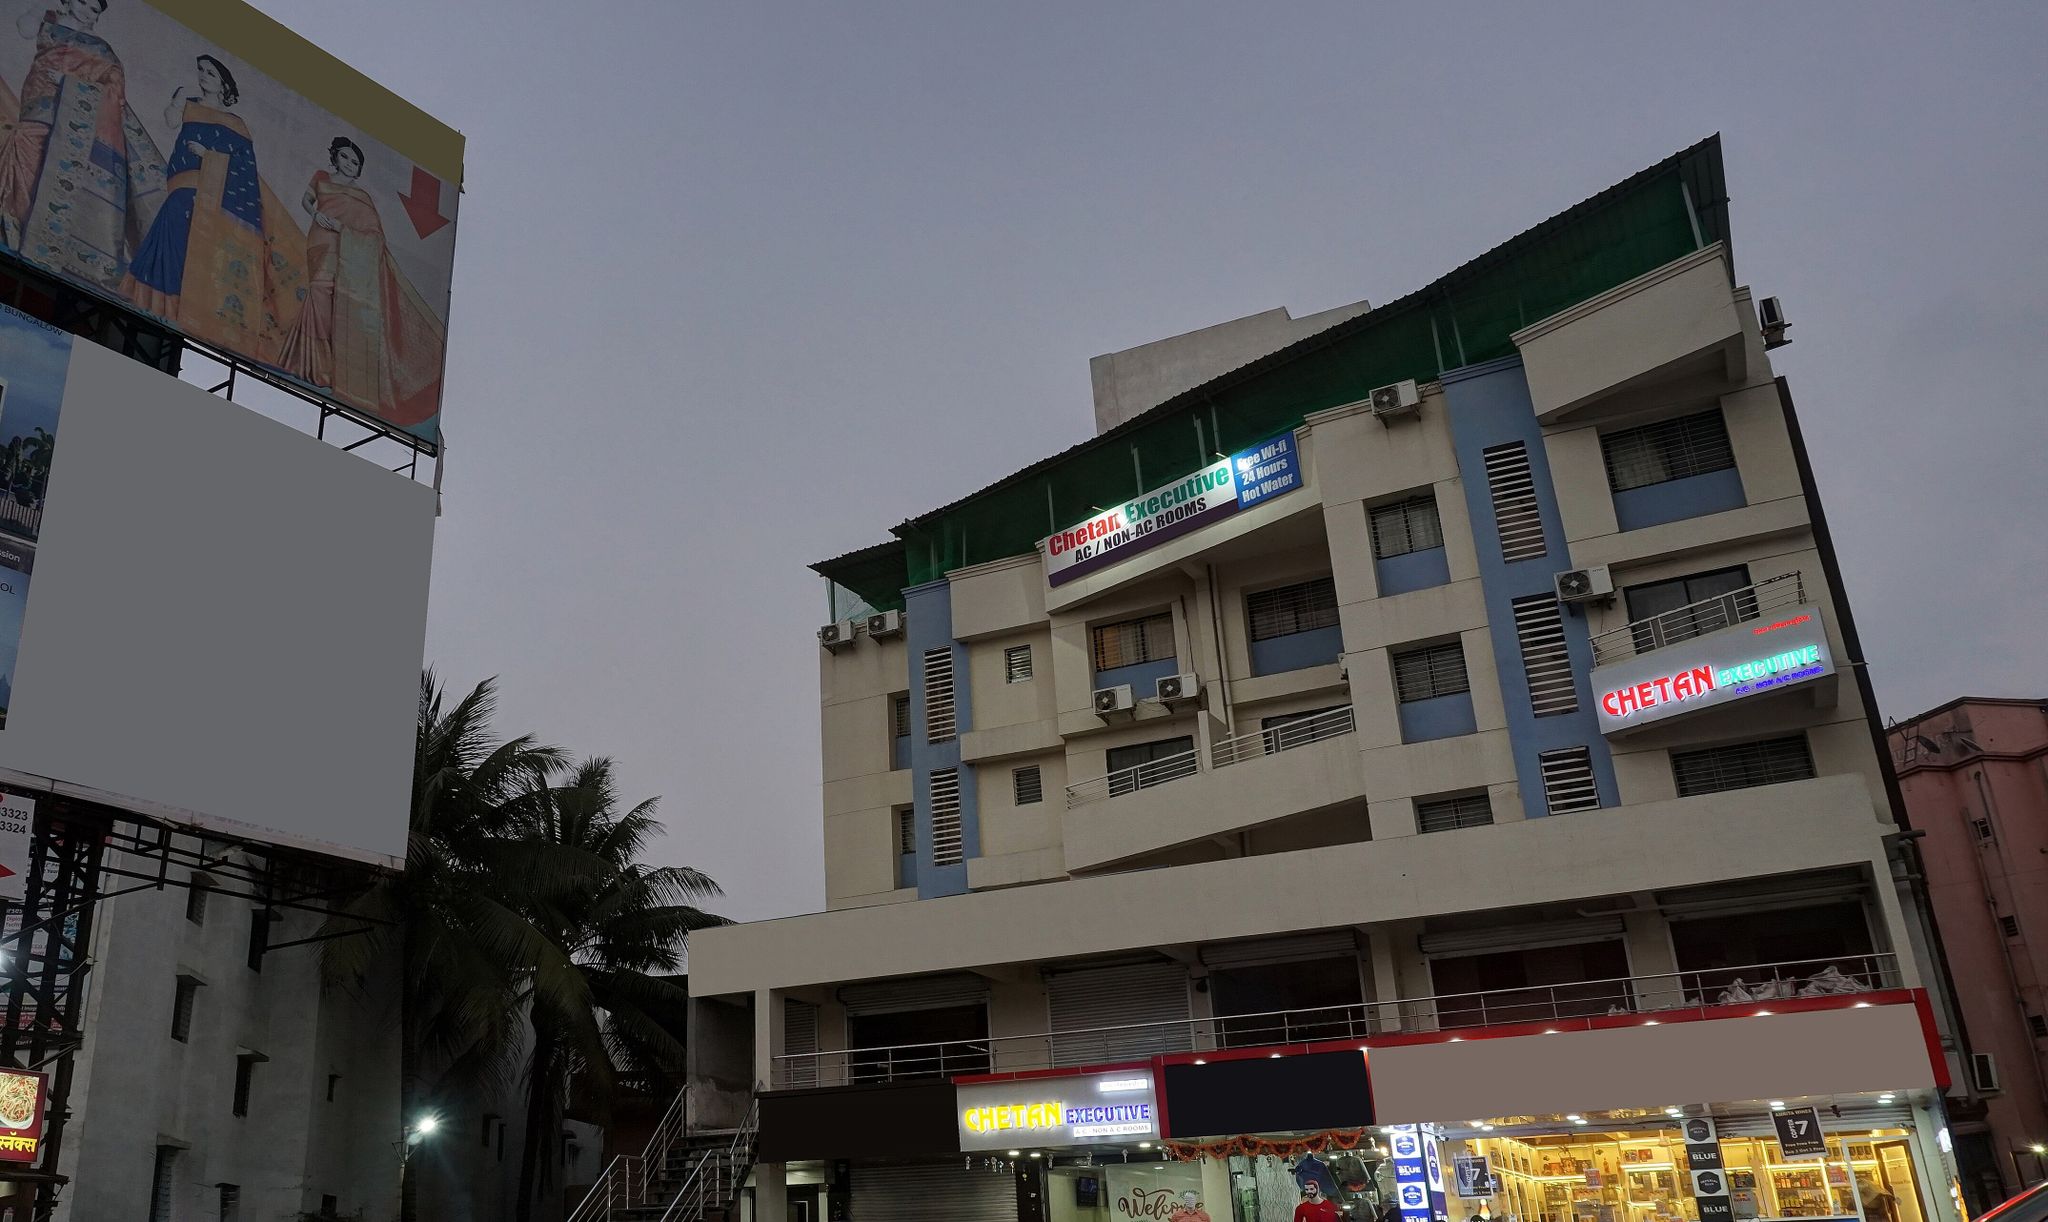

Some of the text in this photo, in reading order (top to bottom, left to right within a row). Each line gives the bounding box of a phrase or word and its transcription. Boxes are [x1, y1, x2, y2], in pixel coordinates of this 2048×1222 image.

[4, 305, 63, 336] BUNGALOW
[1237, 453, 1260, 471] Free
[1242, 459, 1288, 486] 24 Hours
[1242, 473, 1293, 503] Hot Water
[1049, 466, 1229, 556] Chetan Executive
[1075, 543, 1092, 563] AC
[1104, 519, 1153, 550] NON-AC
[1156, 497, 1207, 529] ROOMS
[1602, 645, 1821, 717] CHETAN EXECUTIVE
[0, 806, 28, 820] 3323
[964, 1100, 1150, 1133] CHETAN EXECUTIVE
[1795, 1120, 1808, 1135] 7
[1692, 1152, 1717, 1160] BLUE
[1703, 1205, 1729, 1214] BLUE
